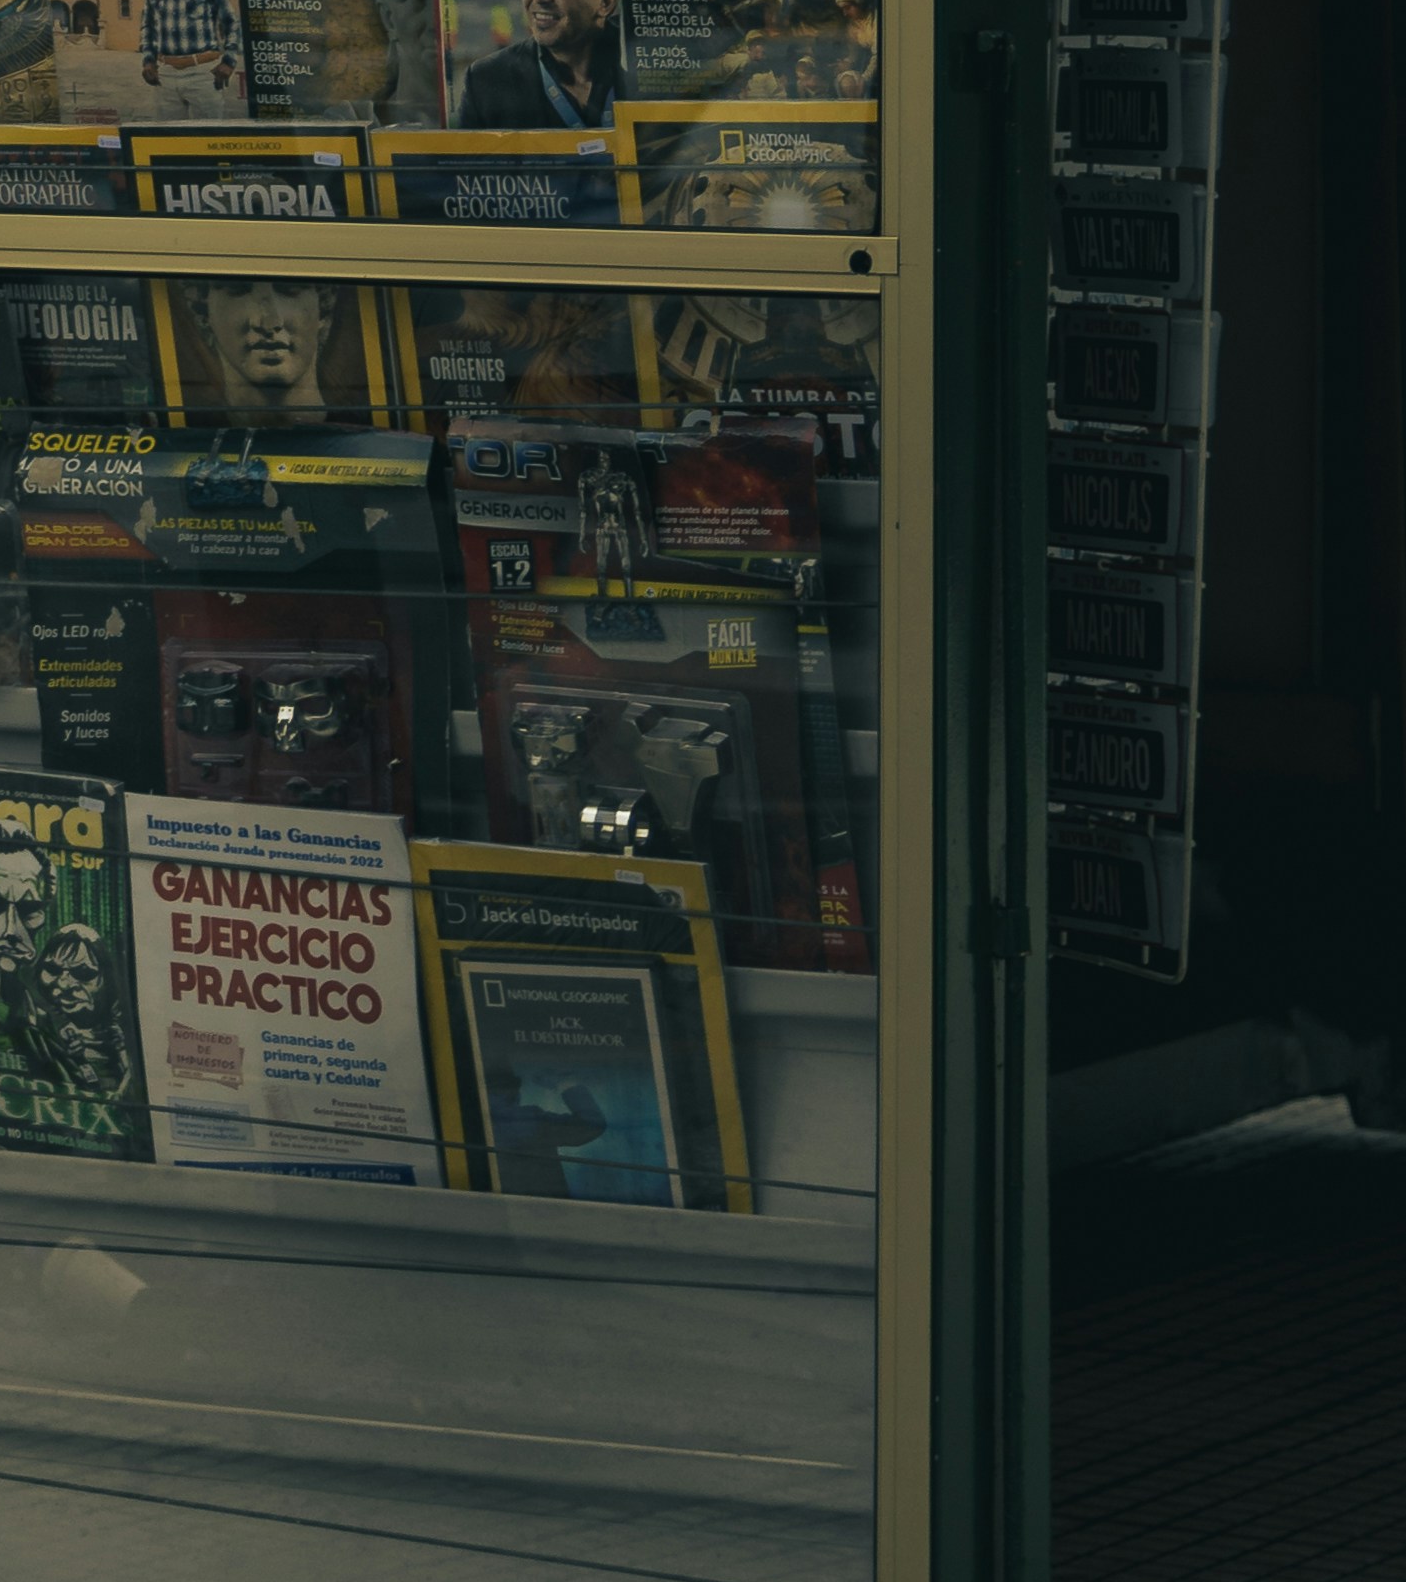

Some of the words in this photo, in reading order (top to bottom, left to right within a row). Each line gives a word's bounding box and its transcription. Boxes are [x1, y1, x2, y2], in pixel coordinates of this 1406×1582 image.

[632, 3, 643, 14] EL
[646, 4, 689, 14] MAYOR
[633, 15, 673, 26] TEMPLO
[634, 26, 711, 38] CRISTIANDAD
[253, 52, 287, 62] SOBRE
[257, 94, 292, 105] ULISES
[1085, 88, 1160, 143] LUDMILA
[748, 134, 813, 147] NATIONAL
[748, 148, 831, 163] GEOGRAPHIC
[456, 175, 556, 196] NATIONAL
[164, 185, 335, 218] HISTORIA
[443, 196, 570, 219] GEOGRAPHIC
[1088, 190, 1161, 206] ARGENTINA
[1072, 216, 1170, 274] VALENTINA
[430, 354, 506, 383] ORÍGENES
[1084, 346, 1140, 402] ALEXIS
[1073, 447, 1109, 463] RIVER
[1112, 449, 1146, 466] PLATE
[460, 499, 566, 522] GENERACIÓN
[1063, 473, 1152, 533] NICOLAS
[490, 543, 530, 558] ESCALA
[492, 560, 531, 588] 1:2
[32, 624, 59, 640] Ojos
[63, 625, 90, 639] LED
[708, 617, 757, 649] FÁCIL
[1066, 599, 1146, 659] MARTIN
[39, 658, 123, 674] Extremidades
[708, 649, 757, 667] MONTAJE
[47, 674, 117, 688] articuladas
[60, 709, 111, 724] Sonidos
[1049, 729, 1150, 790] LEANDRO
[146, 813, 231, 840] Impuesto
[239, 827, 249, 838] a
[255, 822, 280, 841] las
[288, 827, 381, 852] Ganancias
[147, 834, 219, 854] Declaración
[224, 840, 264, 858] Jurada
[268, 846, 345, 866] presentación
[351, 854, 383, 868] 2022
[152, 860, 391, 927] GANANCIAS
[1071, 859, 1121, 918] JUAN
[481, 907, 511, 926] Jack
[520, 910, 534, 926] el
[539, 909, 640, 934] Destripador
[172, 913, 375, 973] EJERCICIO
[170, 962, 381, 1024] PRACTICO
[507, 988, 557, 1002] NATIONAL
[562, 989, 629, 1005] GEOGRAPHIC
[549, 1017, 581, 1031] JACK
[261, 1030, 330, 1050] Ganancias
[336, 1037, 355, 1051] de
[263, 1047, 322, 1069] primera,
[329, 1053, 386, 1074] segunda
[265, 1066, 307, 1082] cuarta
[311, 1071, 322, 1086] y
[327, 1071, 381, 1089] Cedular
